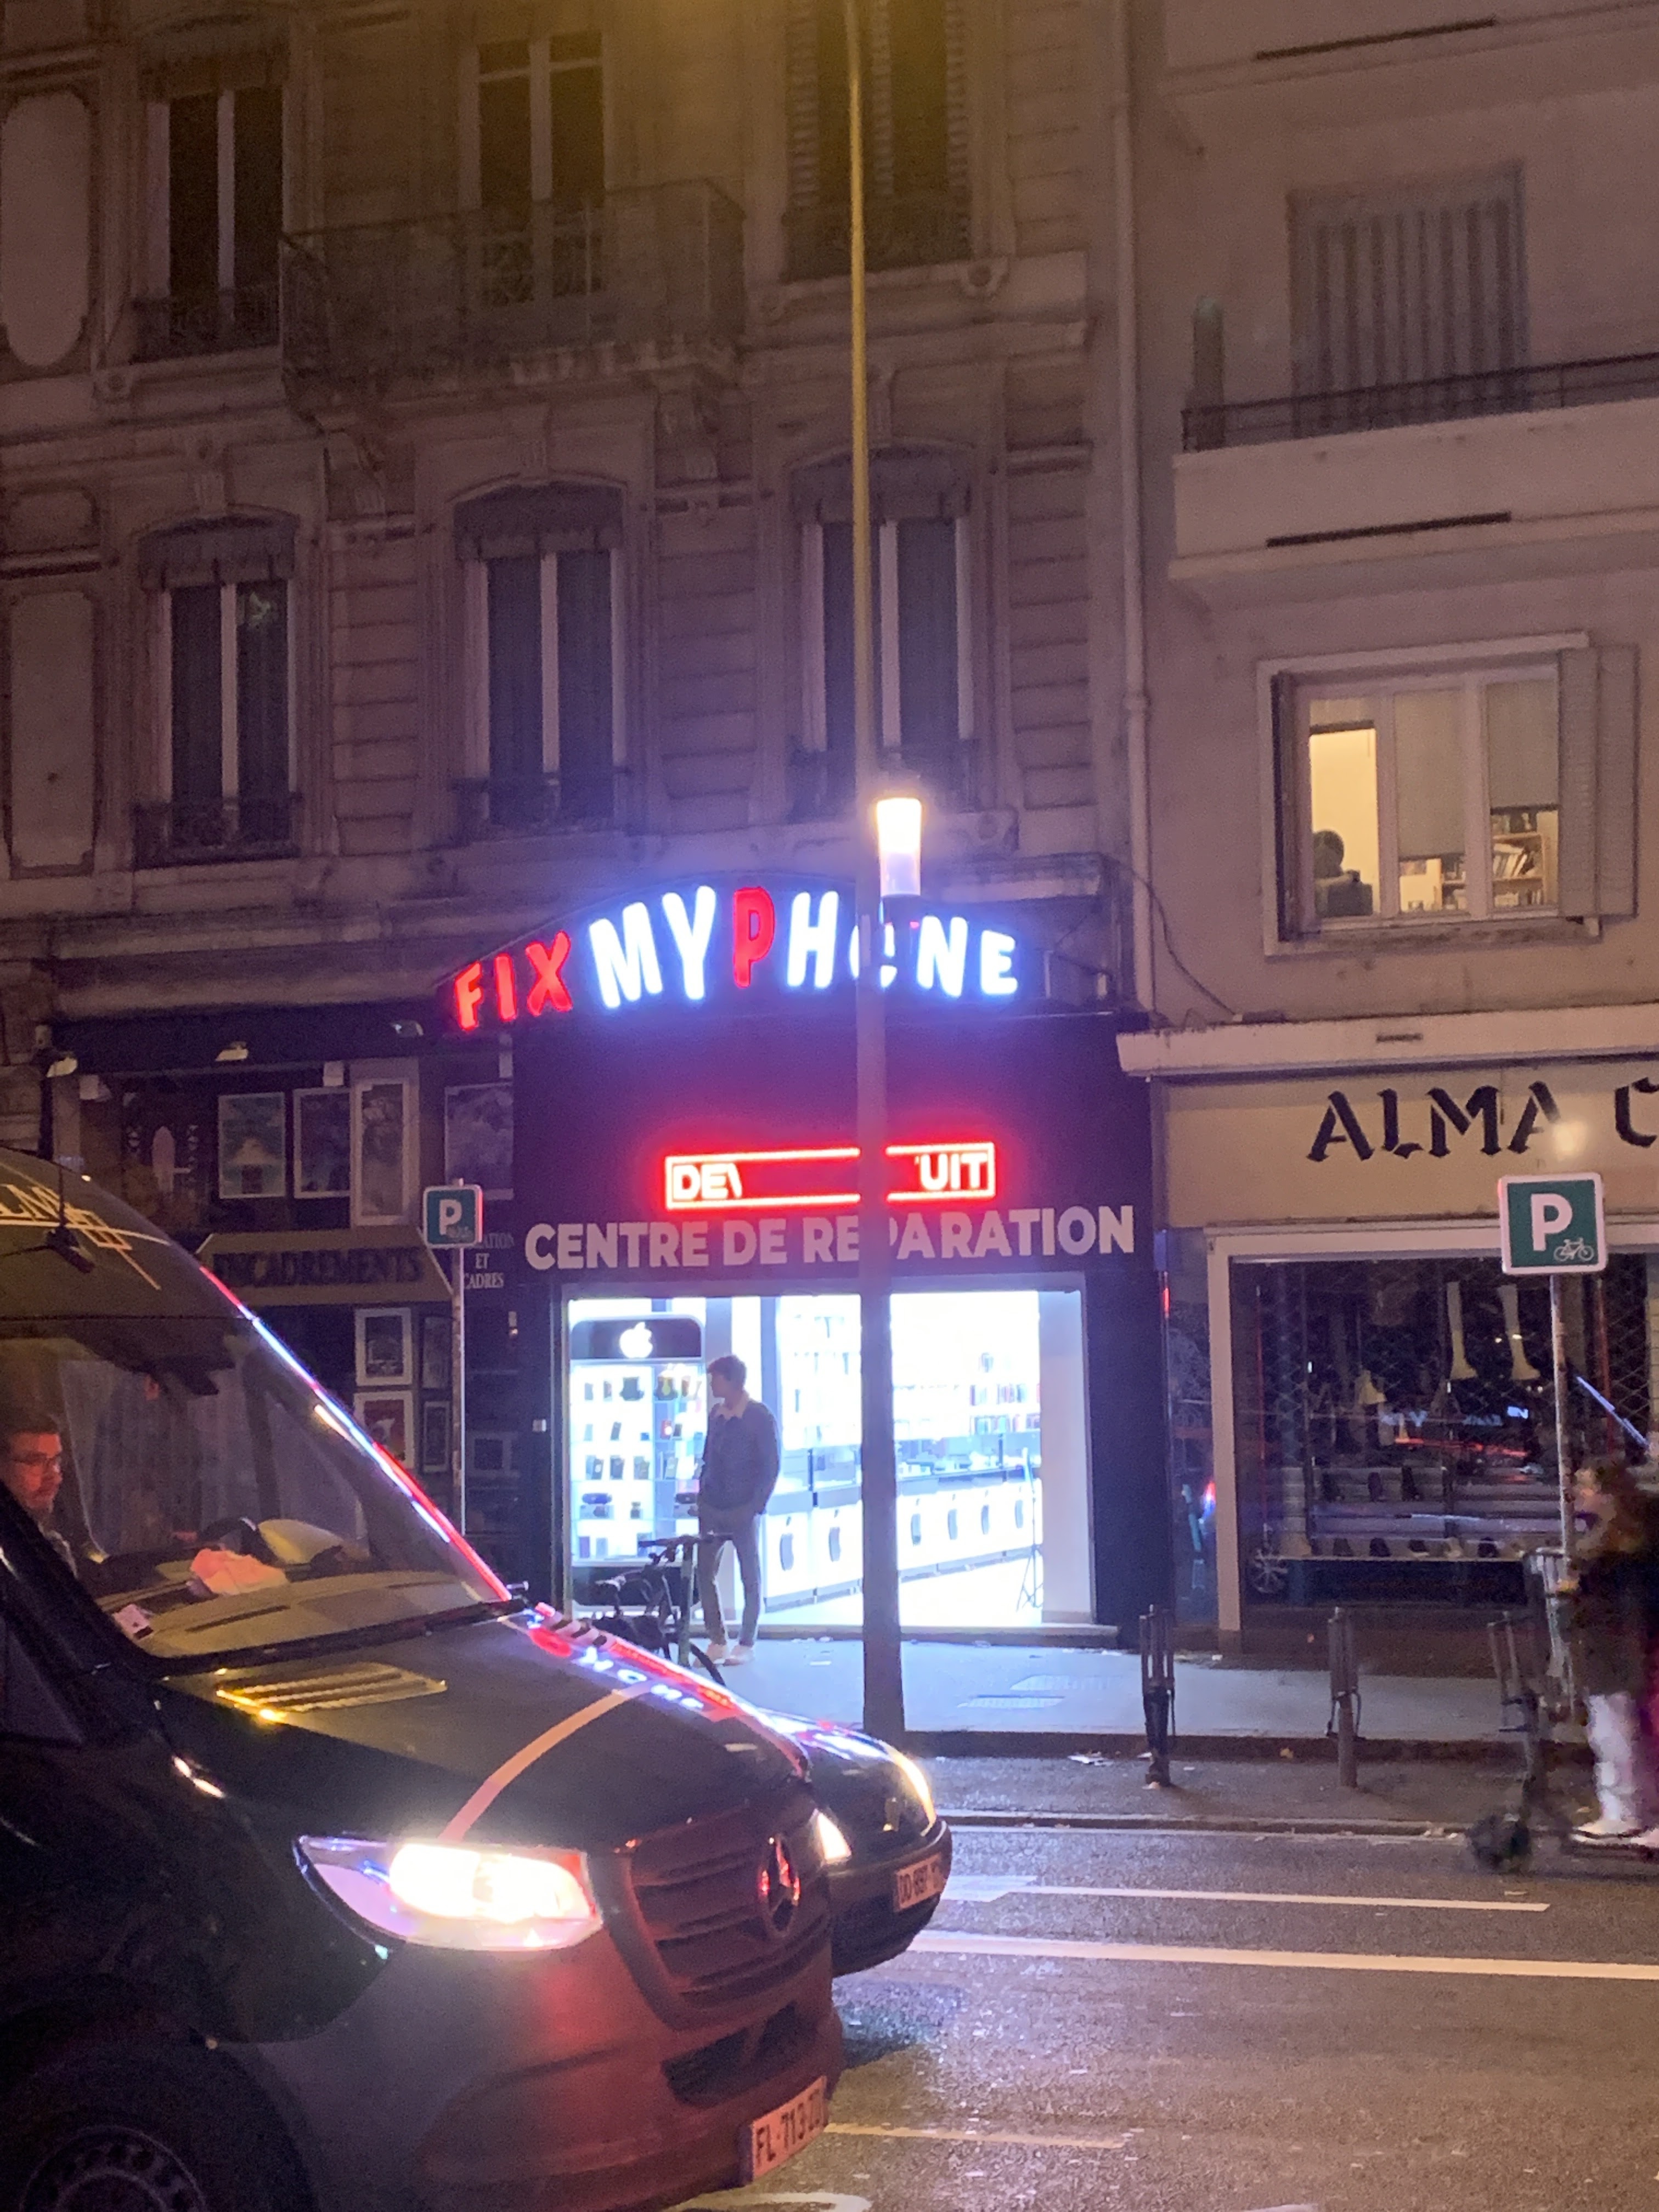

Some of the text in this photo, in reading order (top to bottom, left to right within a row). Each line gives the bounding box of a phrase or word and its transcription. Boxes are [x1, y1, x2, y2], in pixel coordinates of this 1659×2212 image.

[454, 931, 573, 1031] FIX
[1307, 1081, 1561, 1161] ALMA
[439, 1199, 462, 1235] P
[525, 1206, 1134, 1270] CENTRE DE REARATION
[1531, 1193, 1573, 1251] P
[476, 1253, 490, 1269] ET
